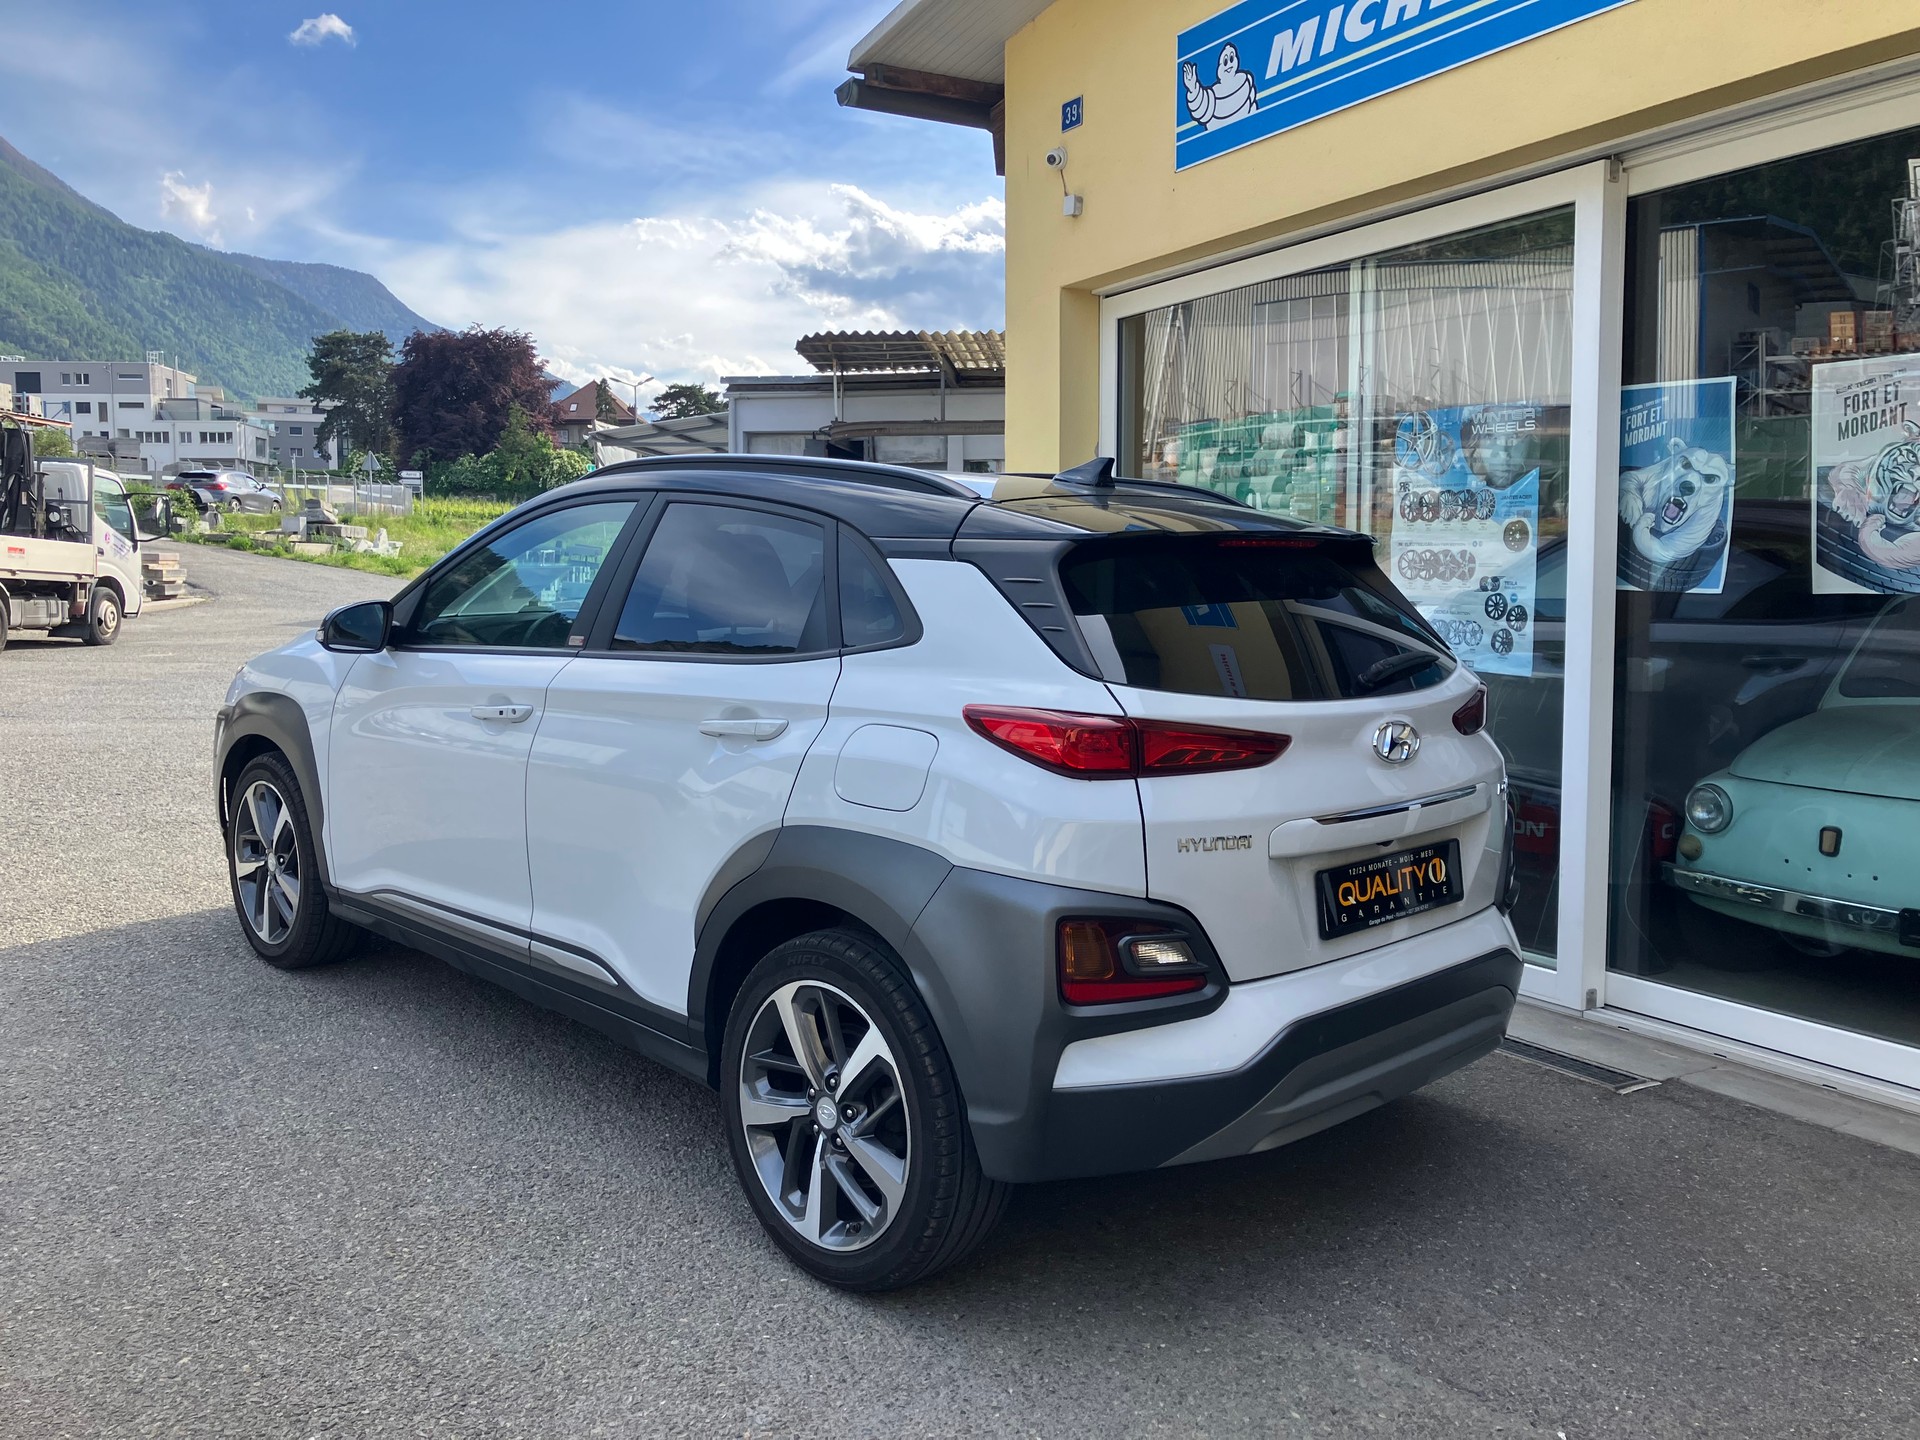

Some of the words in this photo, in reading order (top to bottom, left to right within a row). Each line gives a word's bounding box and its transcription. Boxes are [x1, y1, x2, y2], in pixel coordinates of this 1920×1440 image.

[1265, 0, 1453, 80] MICH
[1065, 104, 1078, 125] 39
[1844, 387, 1879, 417] FORT
[1884, 380, 1902, 405] ET
[1471, 408, 1536, 425] WINTER
[1471, 420, 1536, 435] WHEELS
[1626, 410, 1648, 431] FORT
[1650, 406, 1662, 423] ET
[1837, 402, 1908, 441] MORDANT
[1624, 421, 1668, 448] MORDANT
[1177, 834, 1253, 854] HYUNDAI
[1348, 867, 1367, 876] 12/24
[1368, 859, 1393, 872] MONATE
[1399, 853, 1415, 864] MOIS
[1338, 862, 1427, 907] QUALITY
[1341, 885, 1448, 923] GARANTIE
[787, 954, 830, 966] HIFLY
